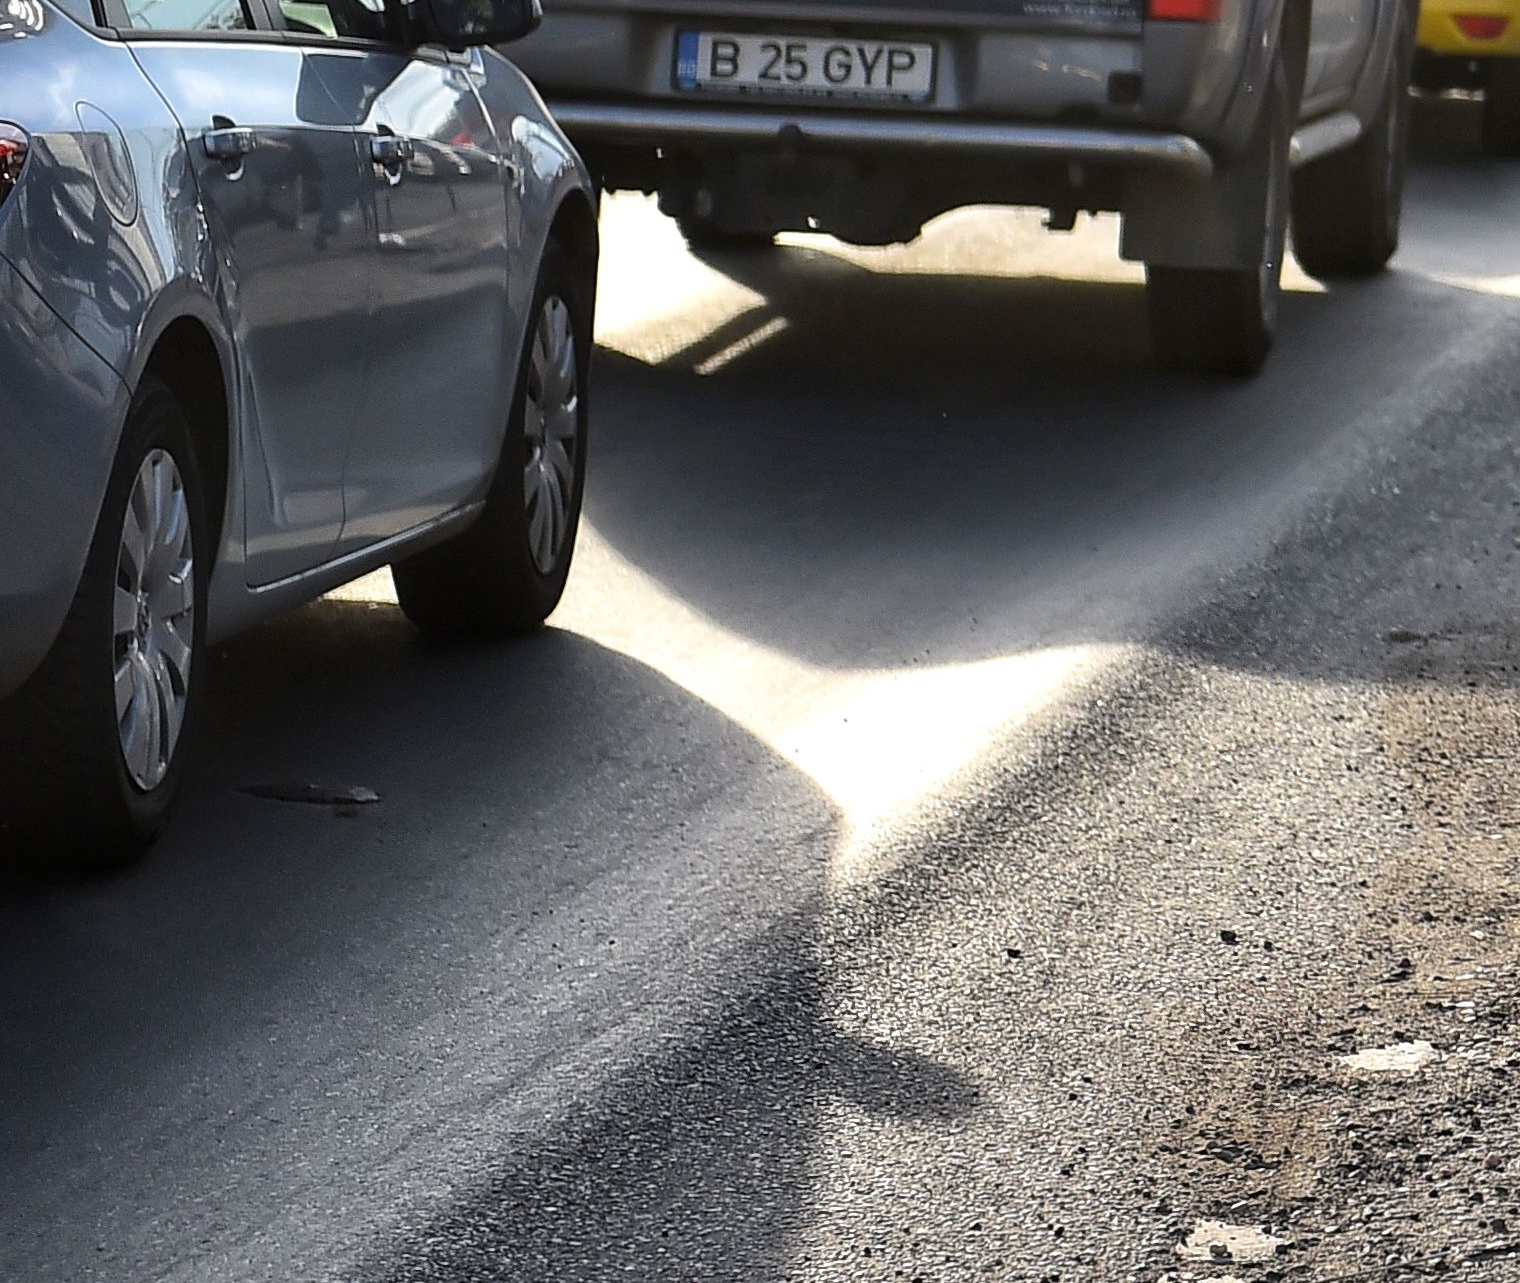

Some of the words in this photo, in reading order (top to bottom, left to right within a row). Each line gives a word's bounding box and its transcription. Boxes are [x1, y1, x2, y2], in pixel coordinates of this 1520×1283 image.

[710, 40, 740, 78] B
[758, 41, 807, 81] 25
[824, 46, 916, 87] GYP
